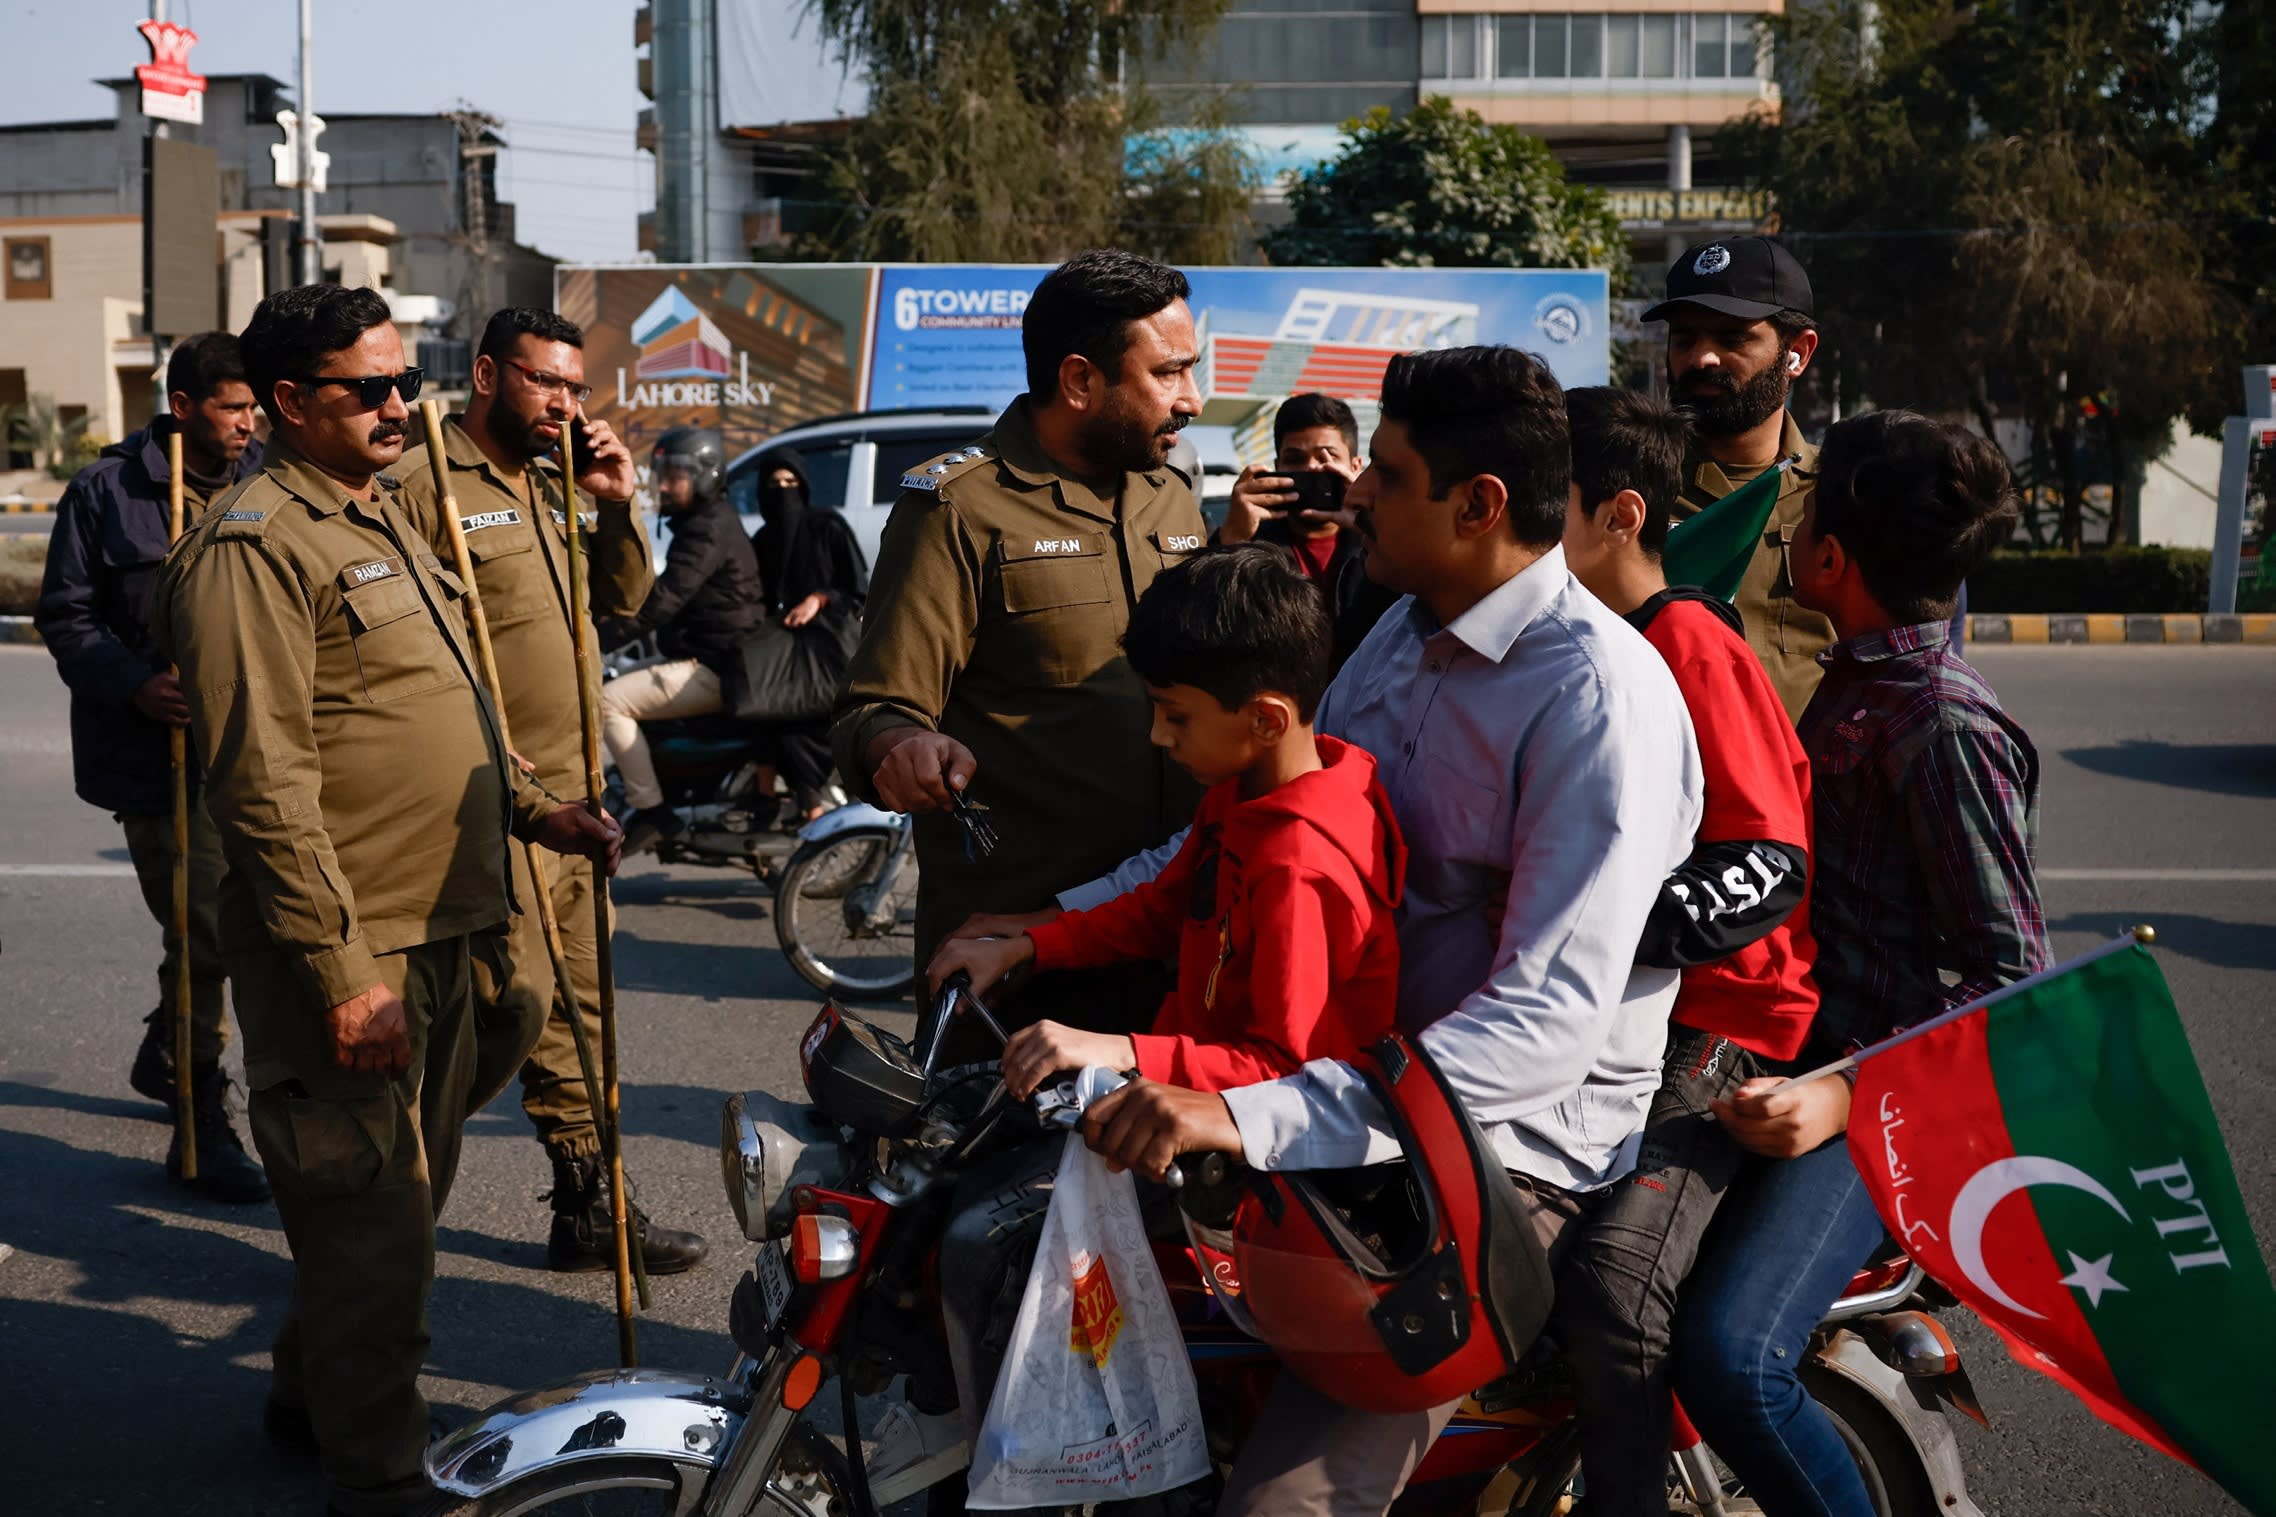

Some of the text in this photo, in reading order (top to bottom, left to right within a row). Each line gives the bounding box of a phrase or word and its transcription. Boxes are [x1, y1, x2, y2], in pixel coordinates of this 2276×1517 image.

[895, 287, 1033, 331] 6 TOWER
[920, 316, 999, 328] COMMUNITY
[617, 351, 775, 410] LAHORE SKY
[469, 512, 511, 528] FAIZAN
[1034, 539, 1081, 553] ARFAN
[1167, 535, 1200, 550] SHO
[354, 562, 392, 583] RAMZAN
[2128, 1156, 2232, 1276] PTI
